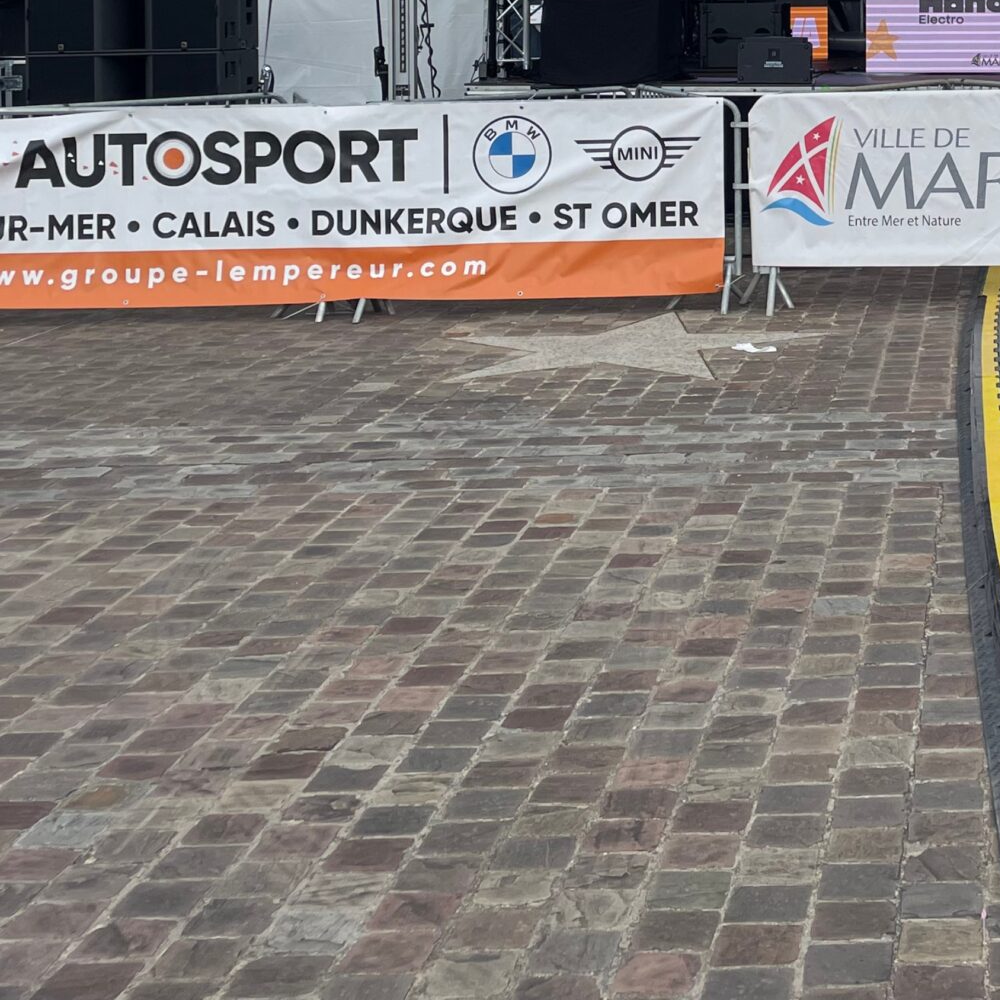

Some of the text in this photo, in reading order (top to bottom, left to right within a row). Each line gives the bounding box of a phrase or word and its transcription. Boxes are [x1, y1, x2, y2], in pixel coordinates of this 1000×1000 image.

[918, 14, 965, 25] Electro
[483, 119, 542, 142] BMW
[854, 127, 971, 149] VILLE DE
[14, 128, 418, 189] AUTOSPORT
[616, 145, 659, 162] MINI
[0, 200, 699, 242] R-MER CALAIS DUNKERQUE ST OMER
[848, 214, 962, 227] Entre Mer et Nature
